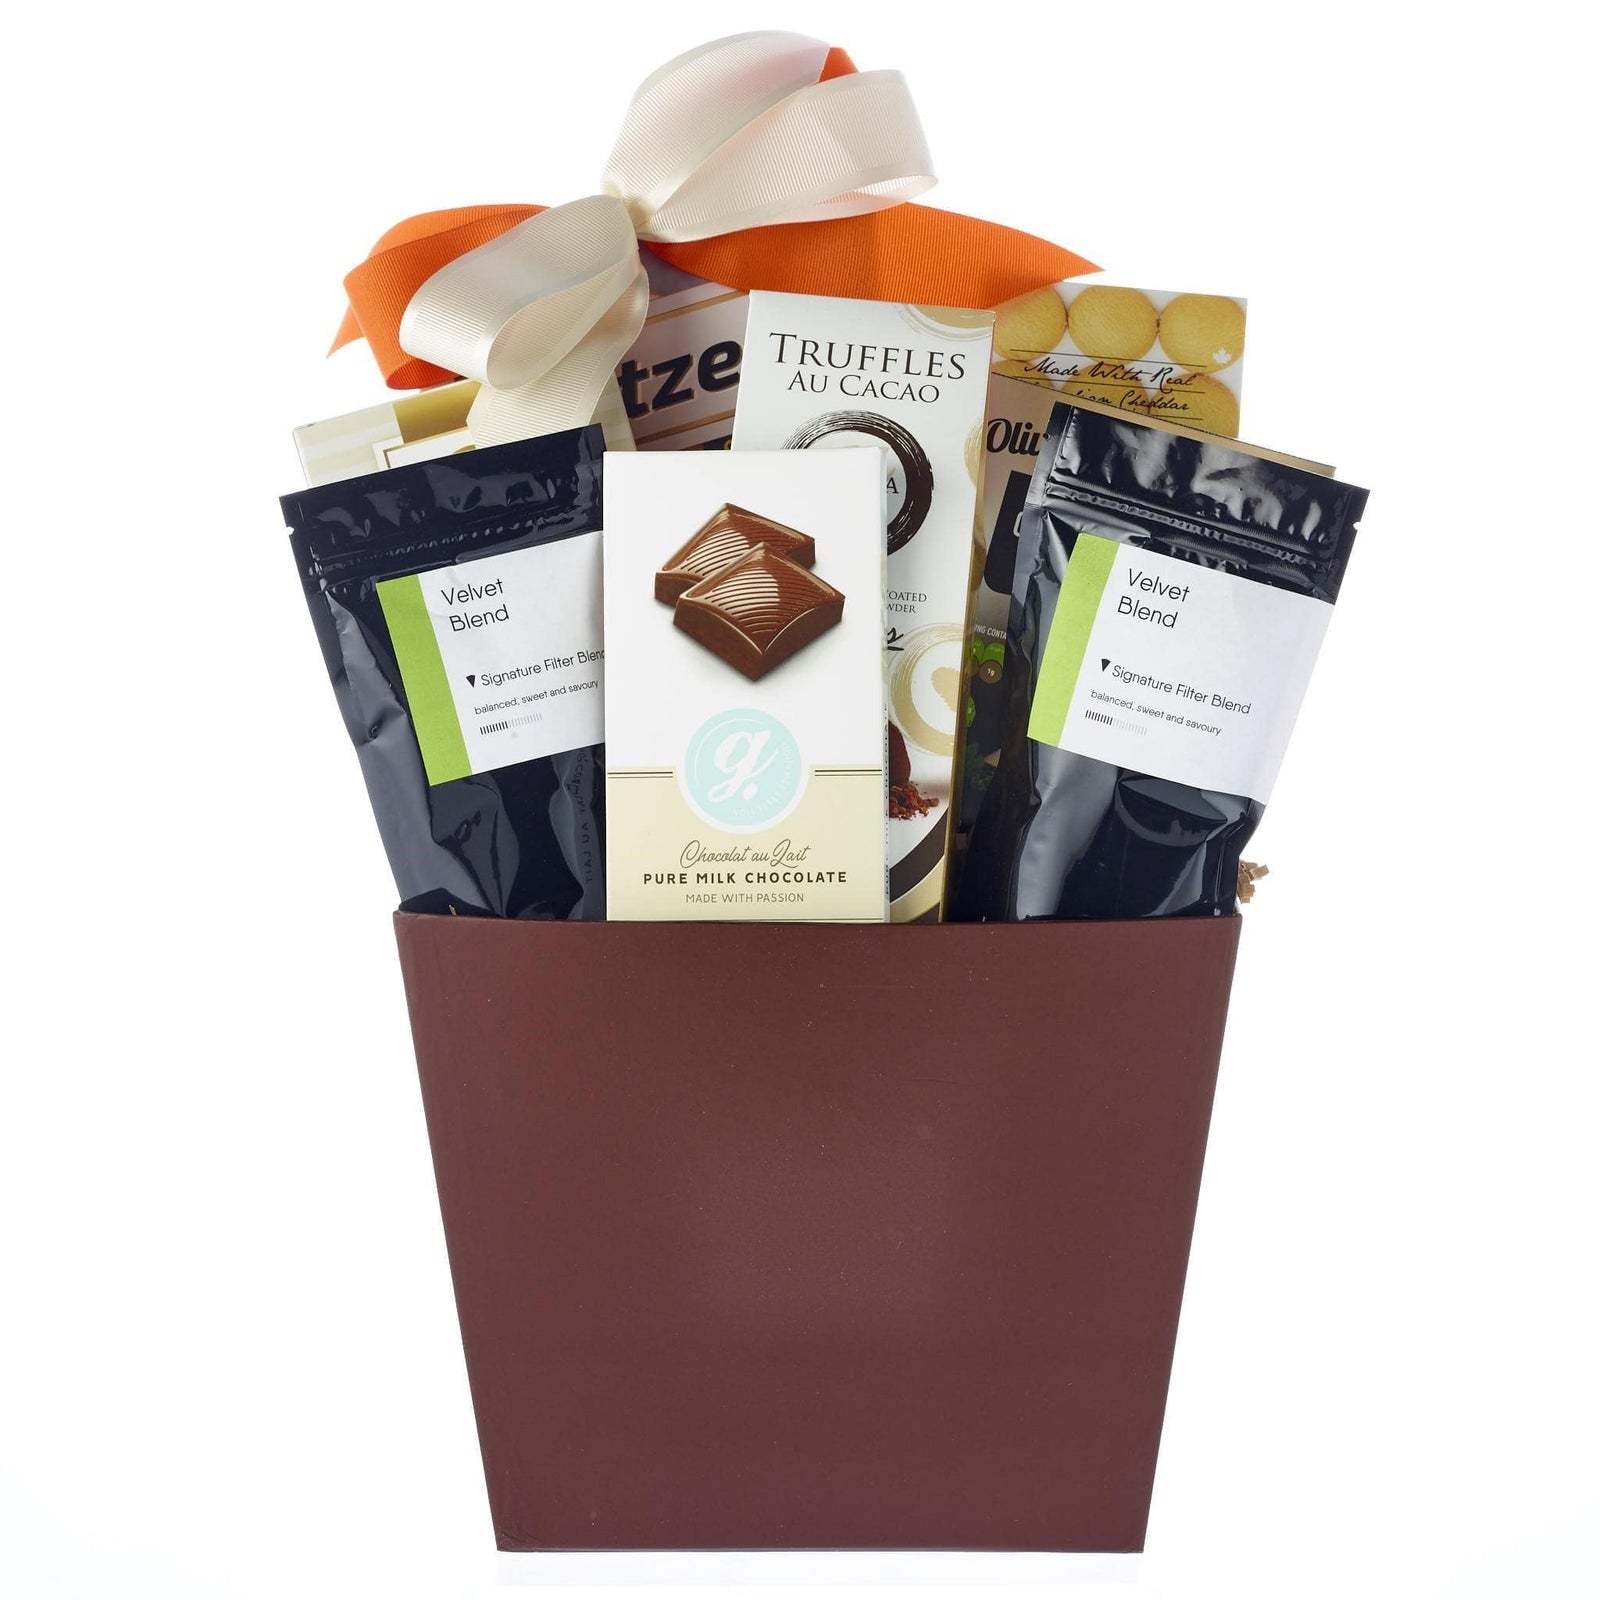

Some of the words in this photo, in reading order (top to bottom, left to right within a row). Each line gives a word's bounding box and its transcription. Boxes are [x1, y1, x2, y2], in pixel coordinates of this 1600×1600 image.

[768, 332, 966, 380] TRUFFLES
[787, 370, 828, 393] AU
[839, 376, 940, 403] CACAO
[1023, 356, 1081, 377] Made
[1088, 361, 1153, 381] With
[1148, 366, 1194, 394] Real
[441, 578, 504, 605] Velvet
[887, 590, 927, 603] OATED
[1128, 568, 1190, 602] Velvet
[449, 603, 509, 632] Blend
[1117, 595, 1178, 628] Blend
[480, 664, 541, 686] Signature
[543, 656, 574, 672] Filter
[474, 697, 520, 715] balanced,
[521, 691, 548, 704] sweet
[549, 686, 567, 698] and
[568, 680, 599, 694] savoury
[1111, 664, 1173, 693] Signature
[1175, 683, 1208, 704] Filter
[1210, 694, 1252, 715] Blend
[1090, 689, 1134, 711] balanced,
[1136, 703, 1165, 718] sweet
[1165, 711, 1184, 726] and
[1185, 717, 1222, 737] savoury
[680, 840, 752, 869] Chocolat
[751, 854, 769, 862] au
[643, 874, 688, 884] PURE
[696, 873, 736, 884] MILK
[745, 872, 847, 884] CHOCOLATE
[685, 893, 717, 904] MADE
[721, 893, 753, 903] WITH
[757, 893, 804, 903] PASSION
